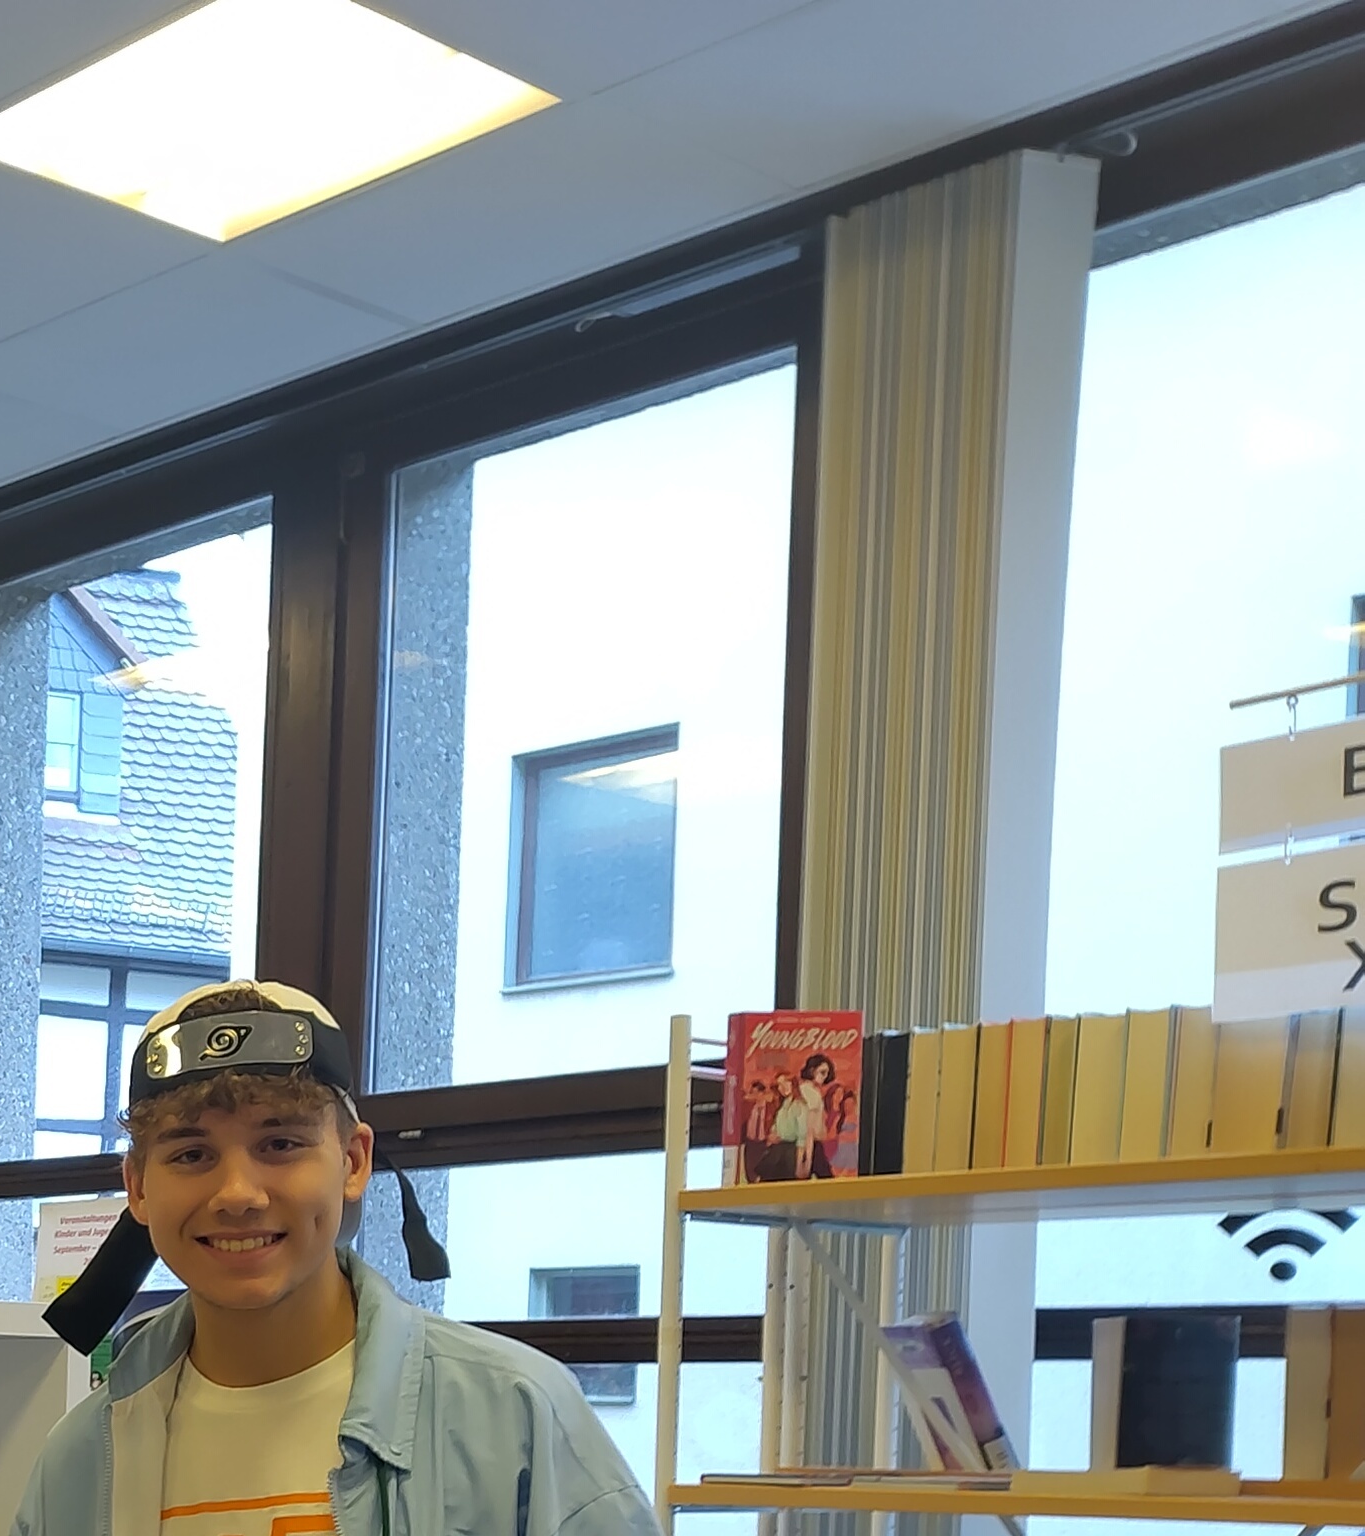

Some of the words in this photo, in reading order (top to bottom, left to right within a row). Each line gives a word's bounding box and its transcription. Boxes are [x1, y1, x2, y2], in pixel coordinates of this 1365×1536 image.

[1318, 880, 1357, 932] S
[745, 1021, 858, 1058] YOUNGBLOOD
[92, 1228, 109, 1238] Juge
